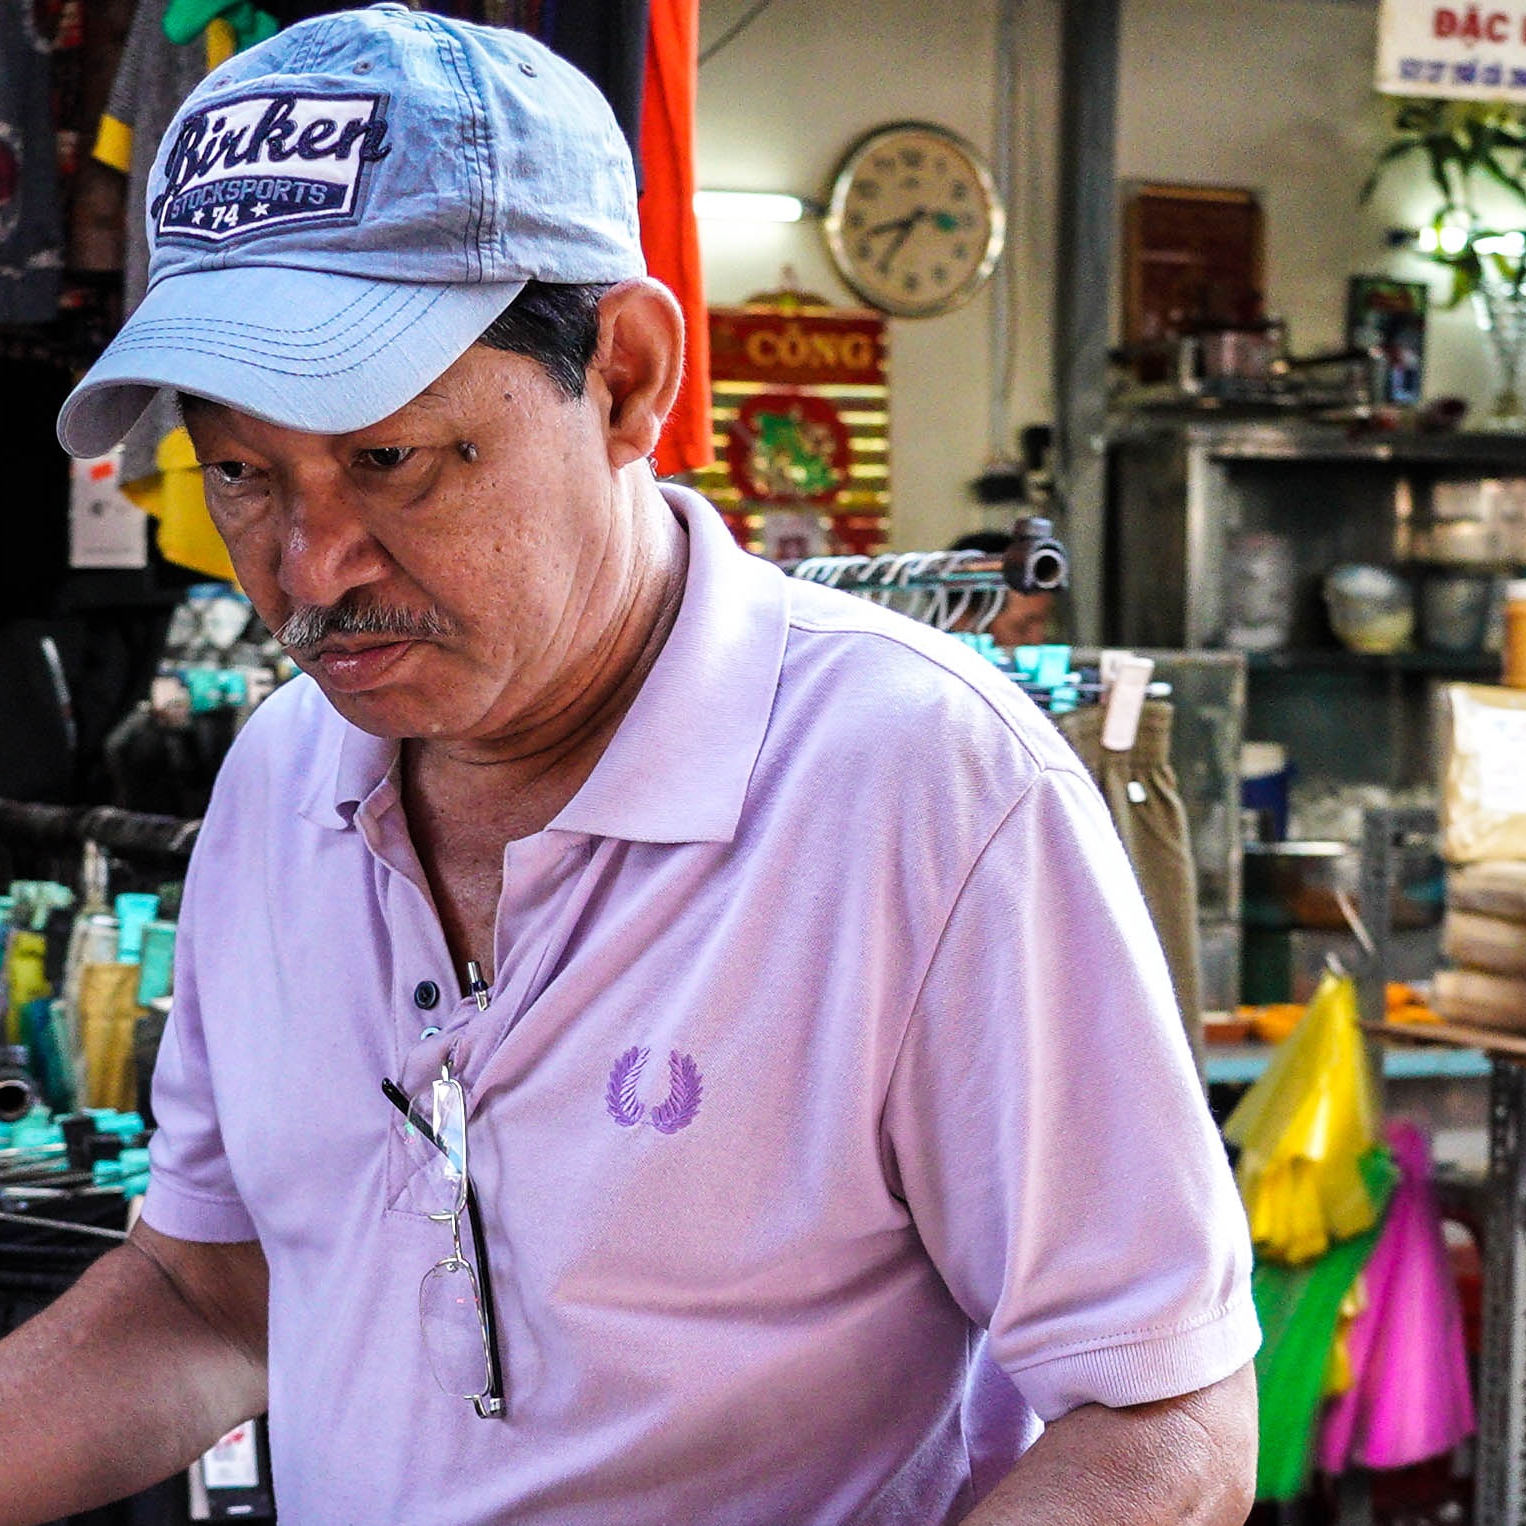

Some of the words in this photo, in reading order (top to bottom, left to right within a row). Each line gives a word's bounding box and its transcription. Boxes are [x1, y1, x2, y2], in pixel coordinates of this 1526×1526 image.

[152, 96, 392, 216] Birken
[171, 179, 329, 219] STOCKSPORTS
[211, 205, 239, 230] 74
